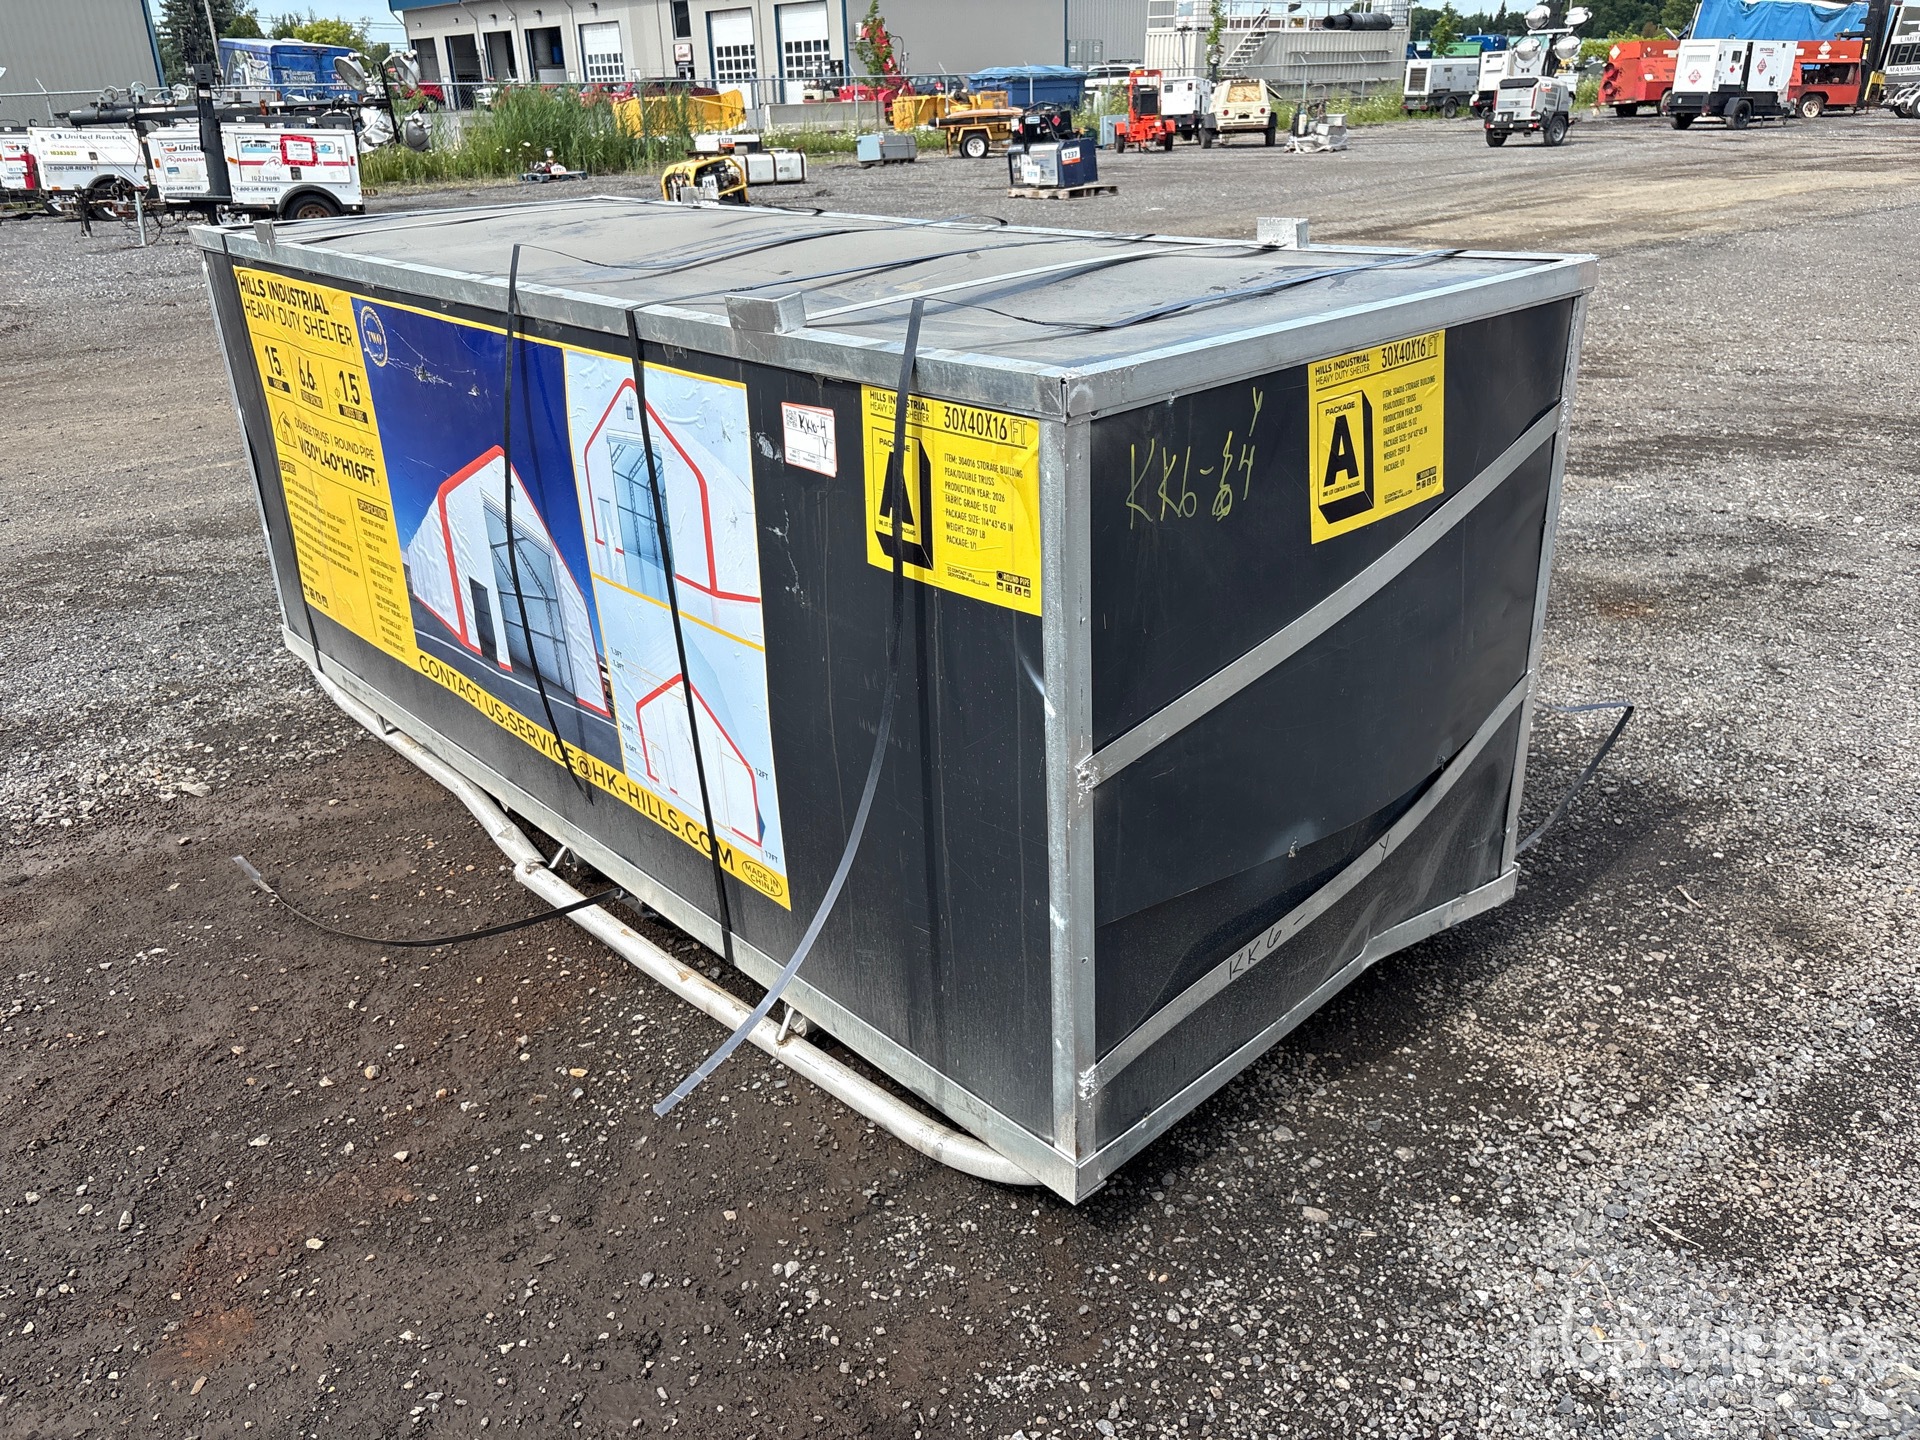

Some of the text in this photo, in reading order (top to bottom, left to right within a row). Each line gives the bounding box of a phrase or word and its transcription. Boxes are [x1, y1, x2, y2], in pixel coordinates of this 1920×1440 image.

[63, 133, 127, 141] United Rentals
[240, 275, 330, 316] HILLS INDUSTRIAL
[243, 298, 276, 324] HEAVY
[278, 306, 301, 332] DUTY
[302, 315, 354, 347] SHELTER
[265, 344, 282, 377] 15
[1381, 333, 1440, 368] 30X40X16 FT
[1315, 354, 1370, 376] HILLS INDUSTRIAL
[1316, 363, 1370, 386] HEAVY DUTY SHELTER
[870, 390, 887, 403] HILLS
[870, 402, 888, 415] HEAVY
[1325, 401, 1356, 416] PACKAGE
[944, 405, 1028, 446] 30X40X16 FT
[1323, 414, 1360, 488] A
[944, 453, 958, 464] ITEM:
[976, 460, 999, 473] STORAGE
[1000, 464, 1024, 479] BUILDING
[944, 467, 995, 486] PEAK/DOUBLE TRUSS
[944, 480, 1006, 502] PRODUCTION YEAR: 2026
[945, 494, 997, 514] FABRIC GRADE: 15 OZ
[945, 508, 967, 521] PACKAGE
[968, 512, 981, 525] SIZE:
[1008, 523, 1014, 532] IN
[946, 521, 986, 539] WEIGHT: 2597 LB
[946, 534, 970, 549] PACKAGE:
[1004, 573, 1031, 587] ROUND PIPE
[419, 654, 482, 709] CONTACT
[755, 767, 768, 780] 12FT
[744, 862, 780, 889] MADE IN
[750, 874, 776, 895] CHINA
